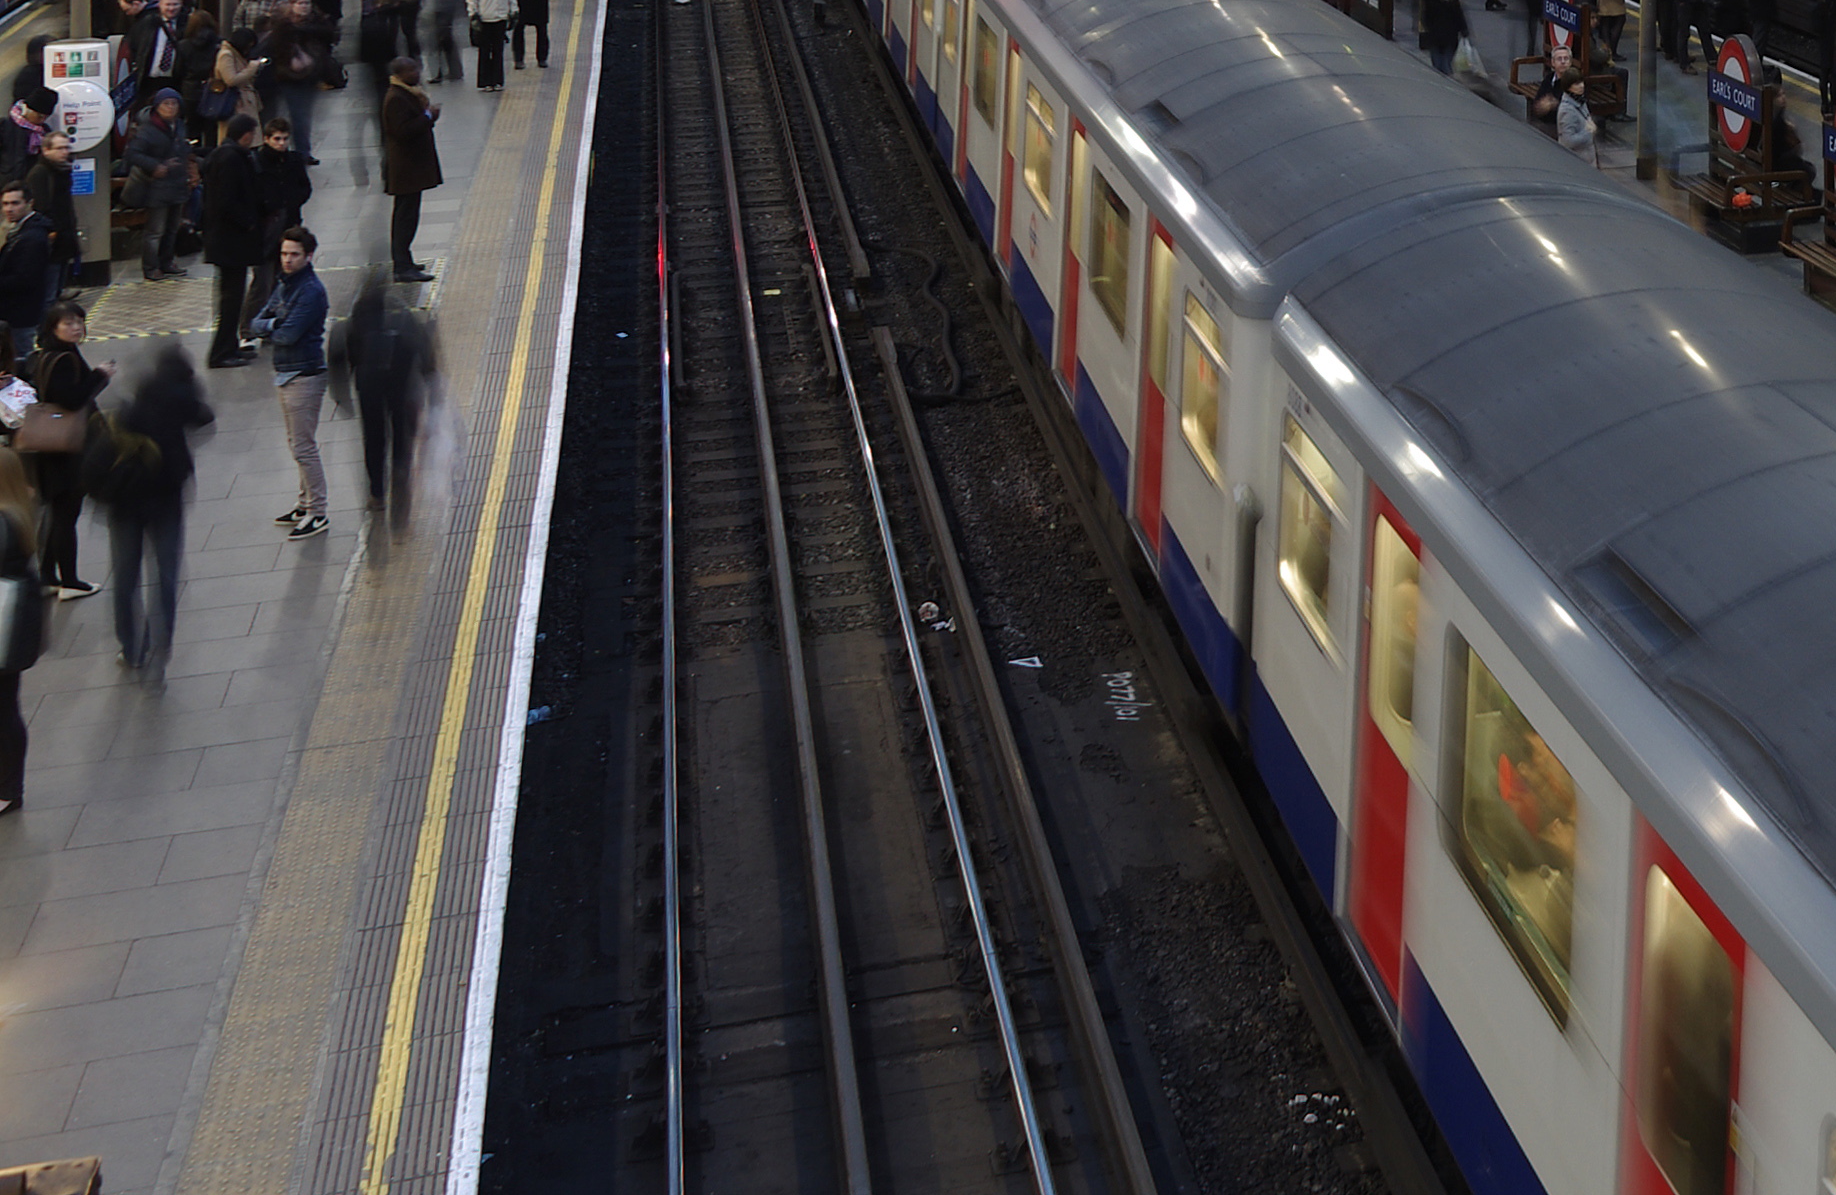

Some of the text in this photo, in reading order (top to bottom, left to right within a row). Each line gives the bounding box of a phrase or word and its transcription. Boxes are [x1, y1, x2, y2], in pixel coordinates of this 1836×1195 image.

[1546, 0, 1576, 25] EARL'S COURT
[1712, 78, 1756, 112] EARL'S COURT
